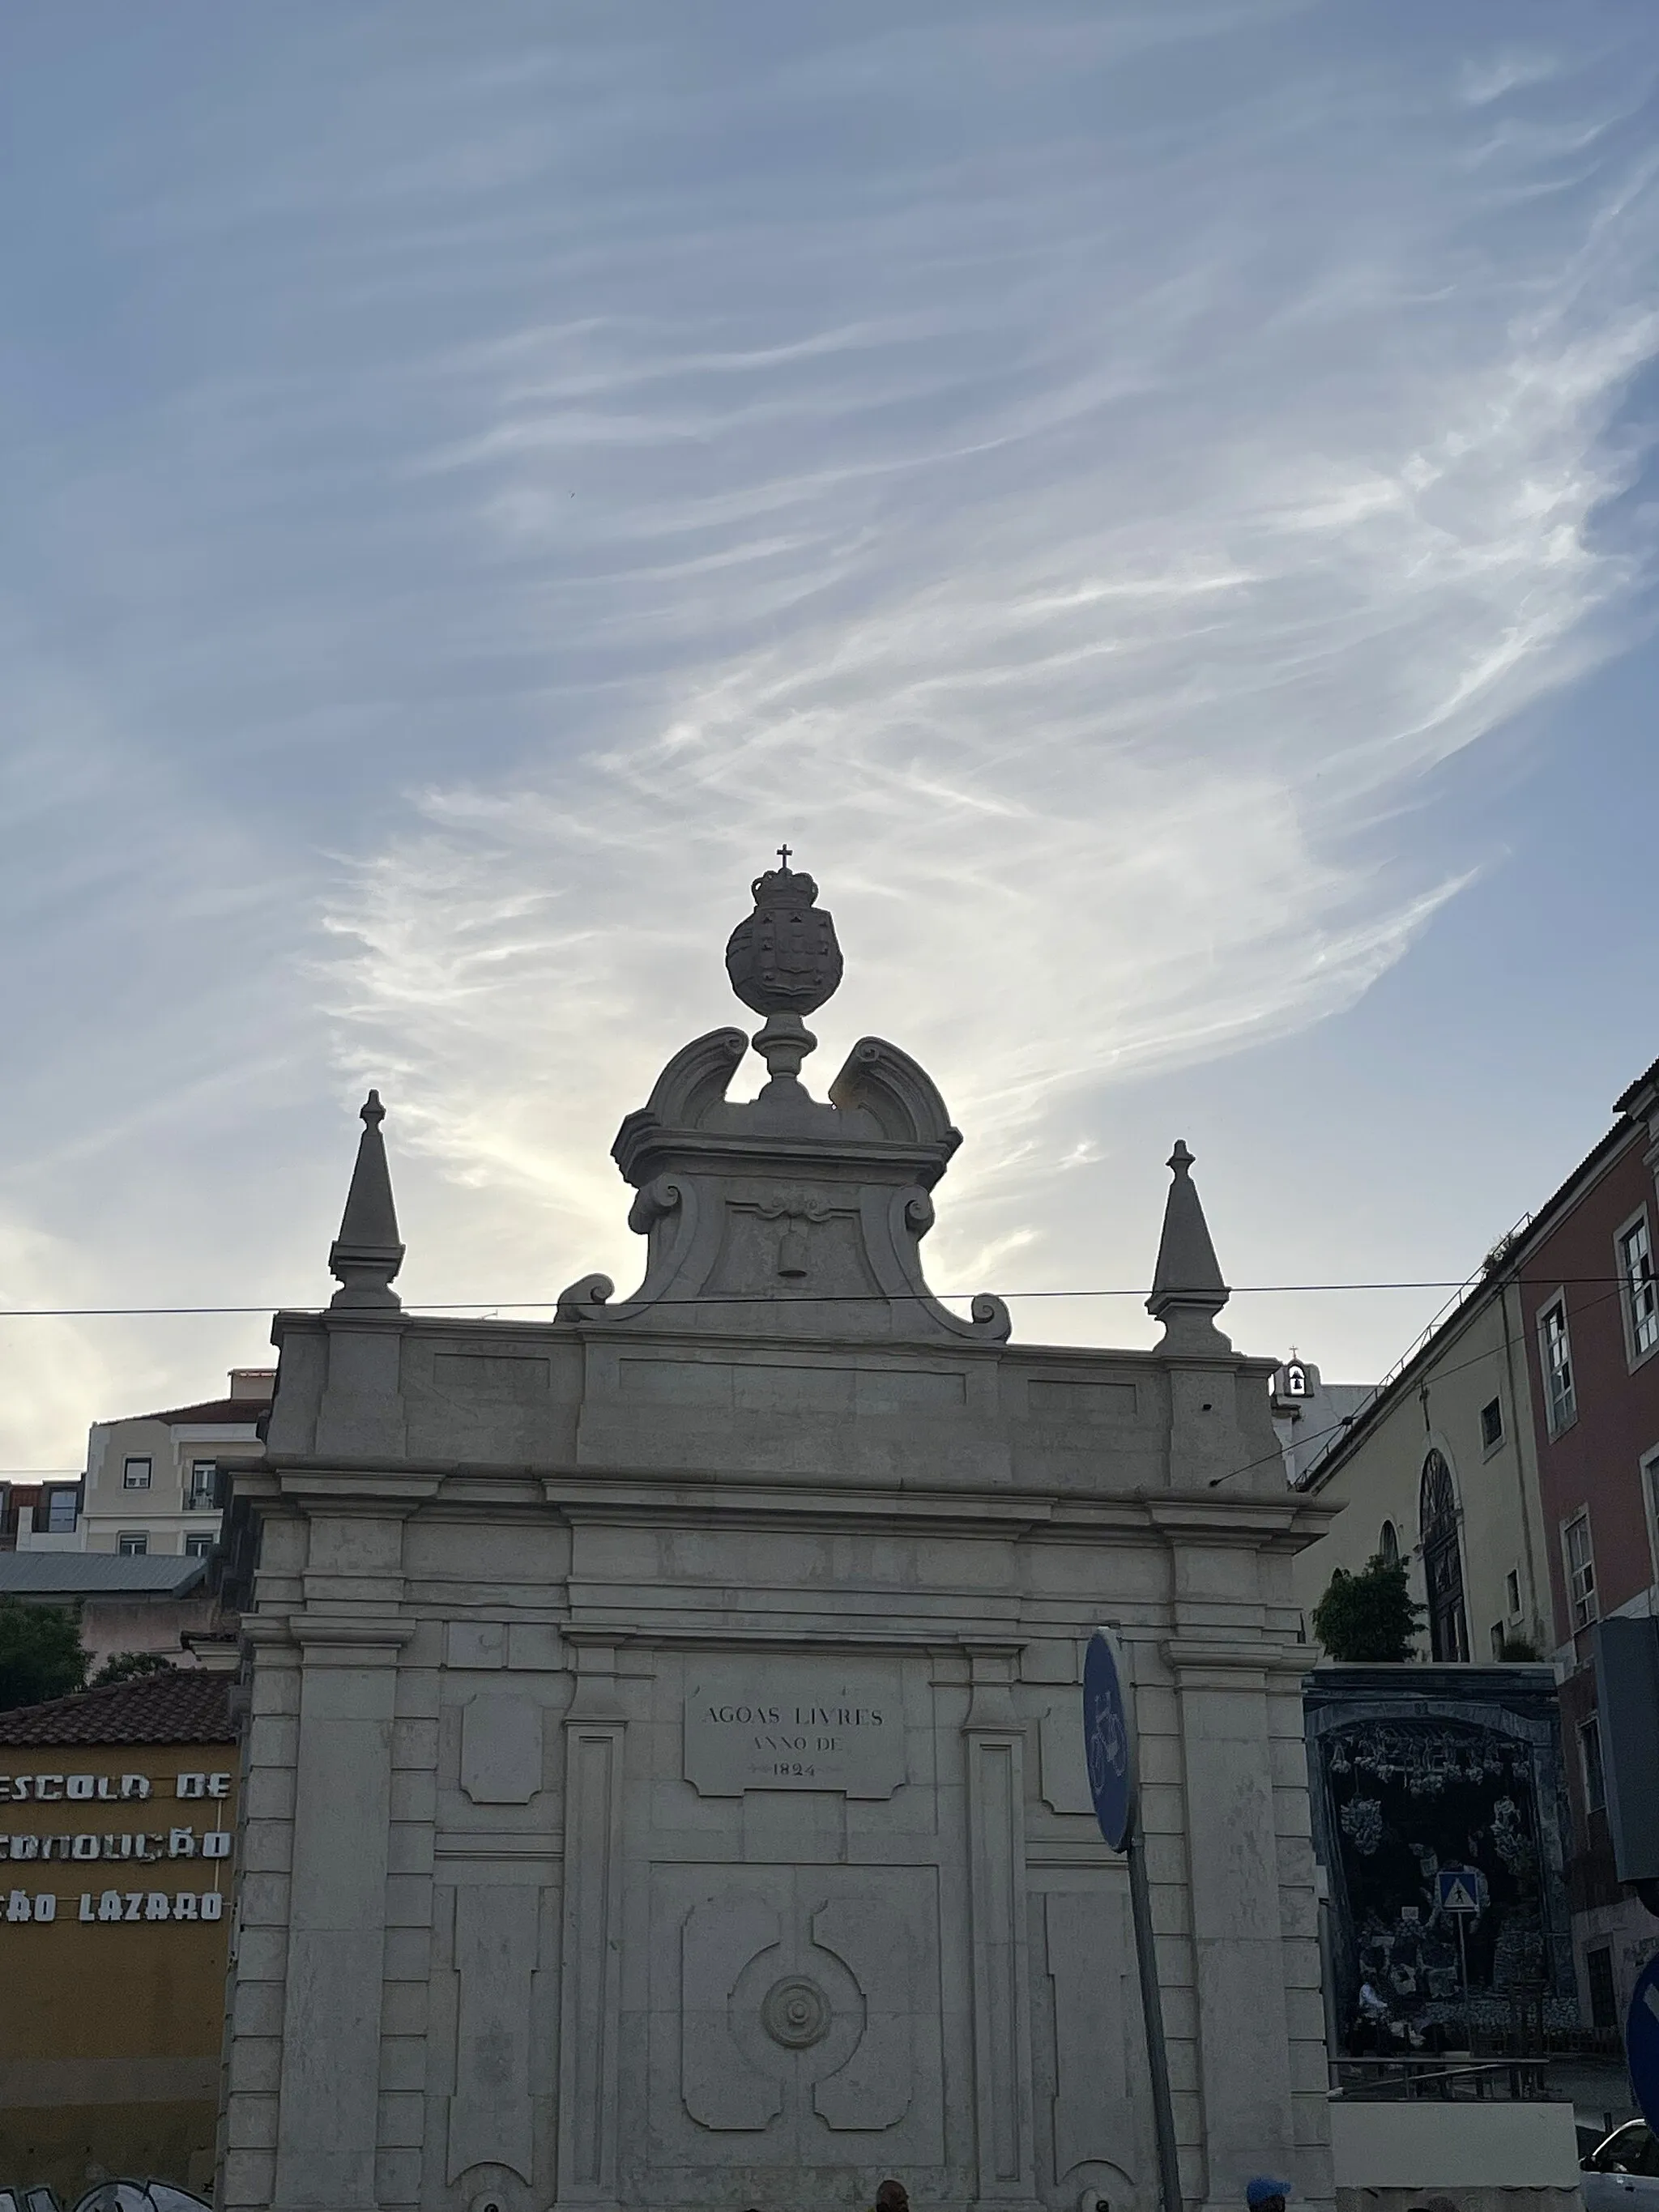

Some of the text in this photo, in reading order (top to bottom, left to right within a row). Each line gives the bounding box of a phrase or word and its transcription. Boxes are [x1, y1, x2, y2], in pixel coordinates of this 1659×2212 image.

[702, 1706, 883, 1726] AGOAS LIVRES
[817, 1737, 844, 1751] DE
[773, 1762, 814, 1776] 1824
[176, 1772, 232, 1799] DE
[0, 1890, 223, 1922] ÃO LÁZARO
